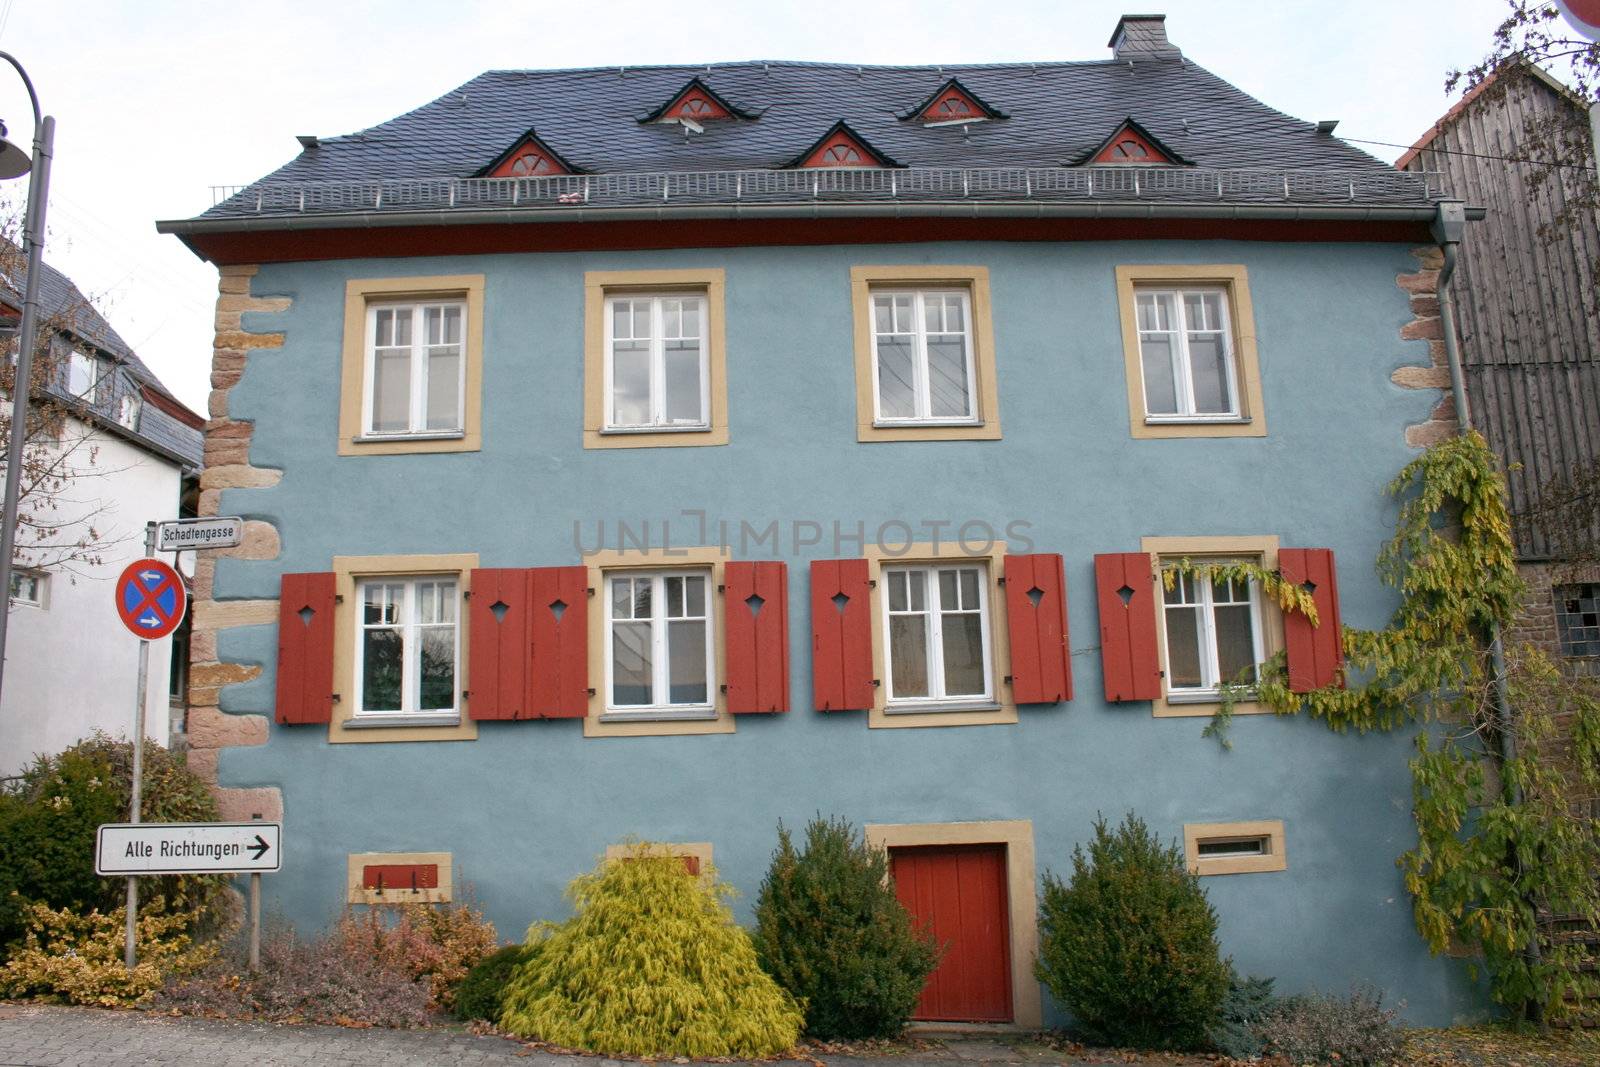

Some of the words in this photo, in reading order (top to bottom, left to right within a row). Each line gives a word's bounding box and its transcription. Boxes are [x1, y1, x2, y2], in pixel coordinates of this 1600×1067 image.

[164, 527, 234, 542] Schadtengasse
[125, 841, 153, 858] Alle
[160, 840, 239, 860] Richtungen
